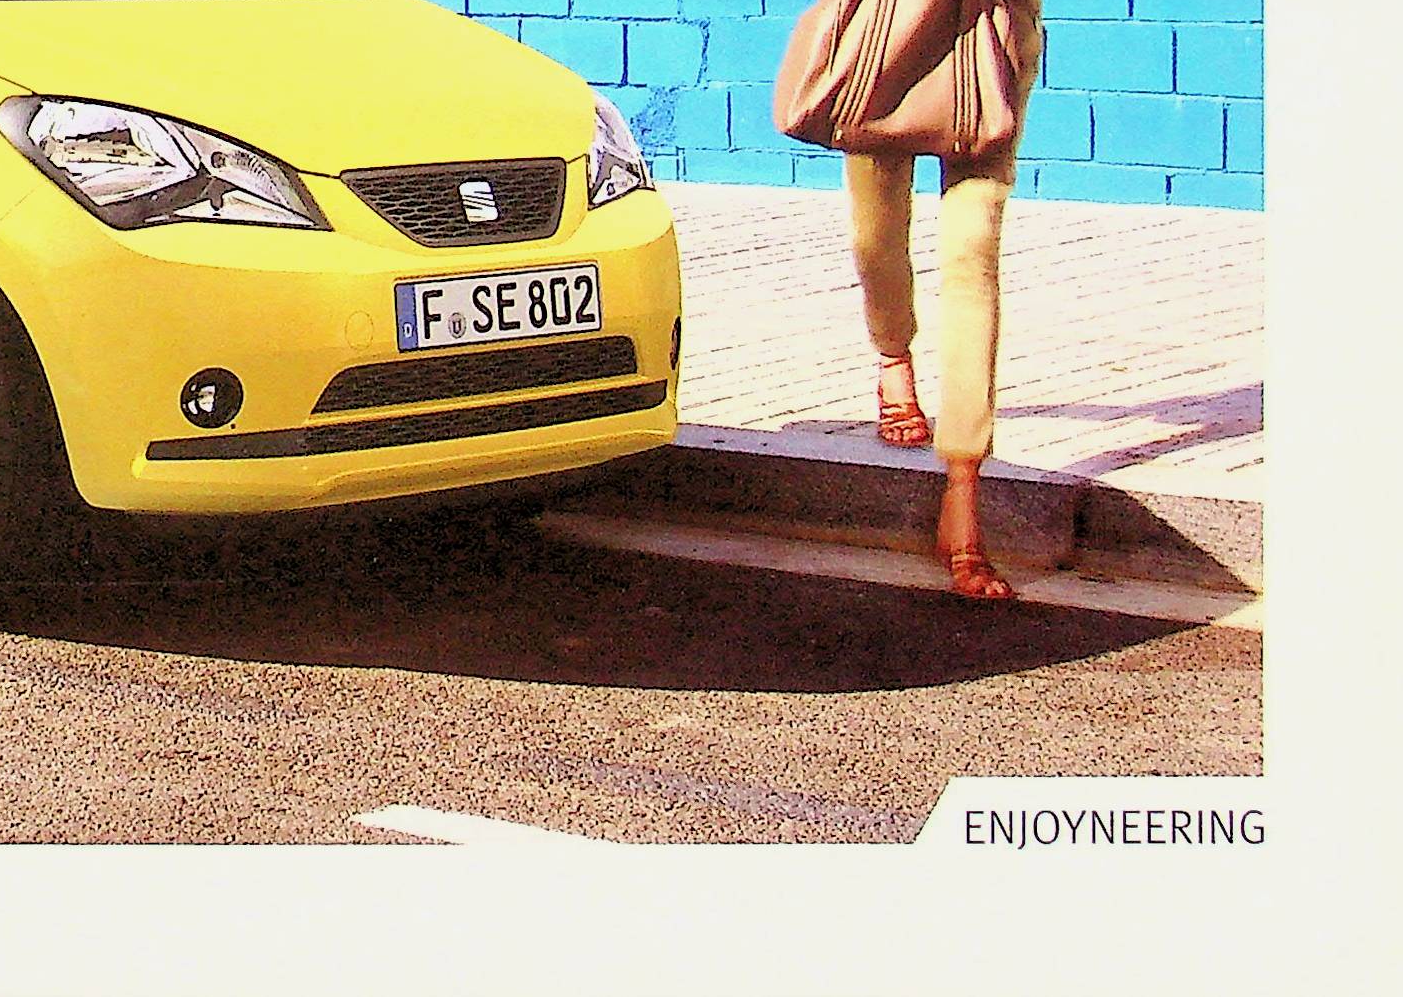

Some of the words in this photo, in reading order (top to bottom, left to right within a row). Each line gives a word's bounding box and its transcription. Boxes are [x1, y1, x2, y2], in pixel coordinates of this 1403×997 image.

[422, 289, 443, 339] F
[472, 282, 521, 333] SE
[528, 274, 596, 329] 802
[965, 810, 1266, 850] ENJOYNEERING
